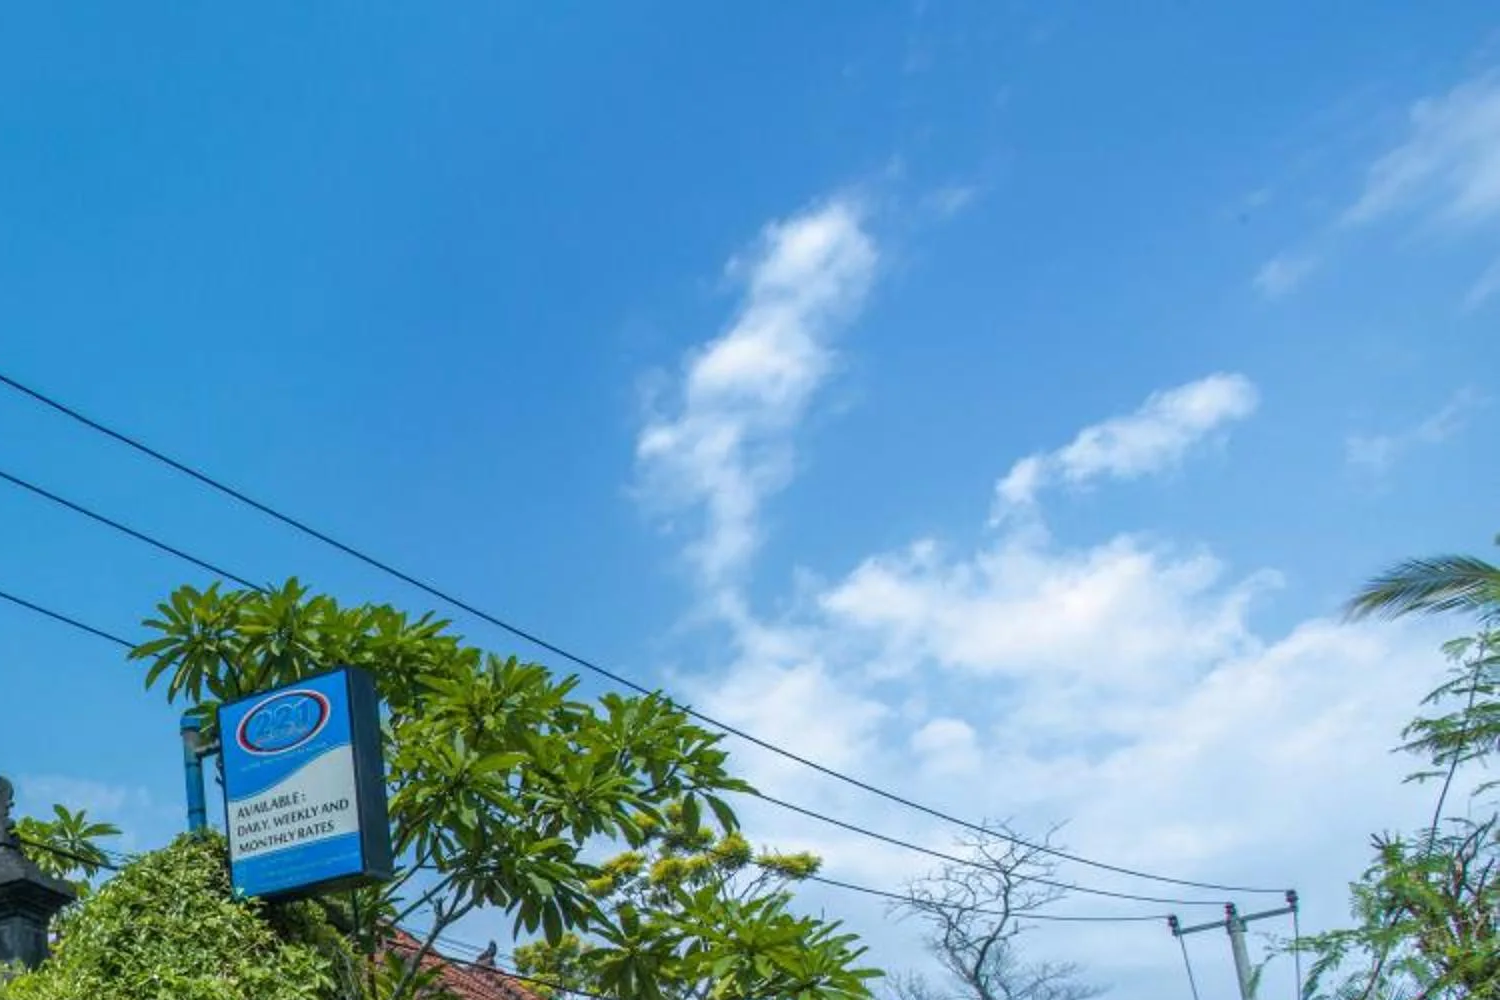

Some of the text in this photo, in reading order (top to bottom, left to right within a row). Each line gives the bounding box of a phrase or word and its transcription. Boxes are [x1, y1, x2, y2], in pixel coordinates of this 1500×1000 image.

[273, 804, 320, 828] WEEKLY
[321, 798, 349, 813] AND
[239, 819, 336, 853] MONTHLY RATES
